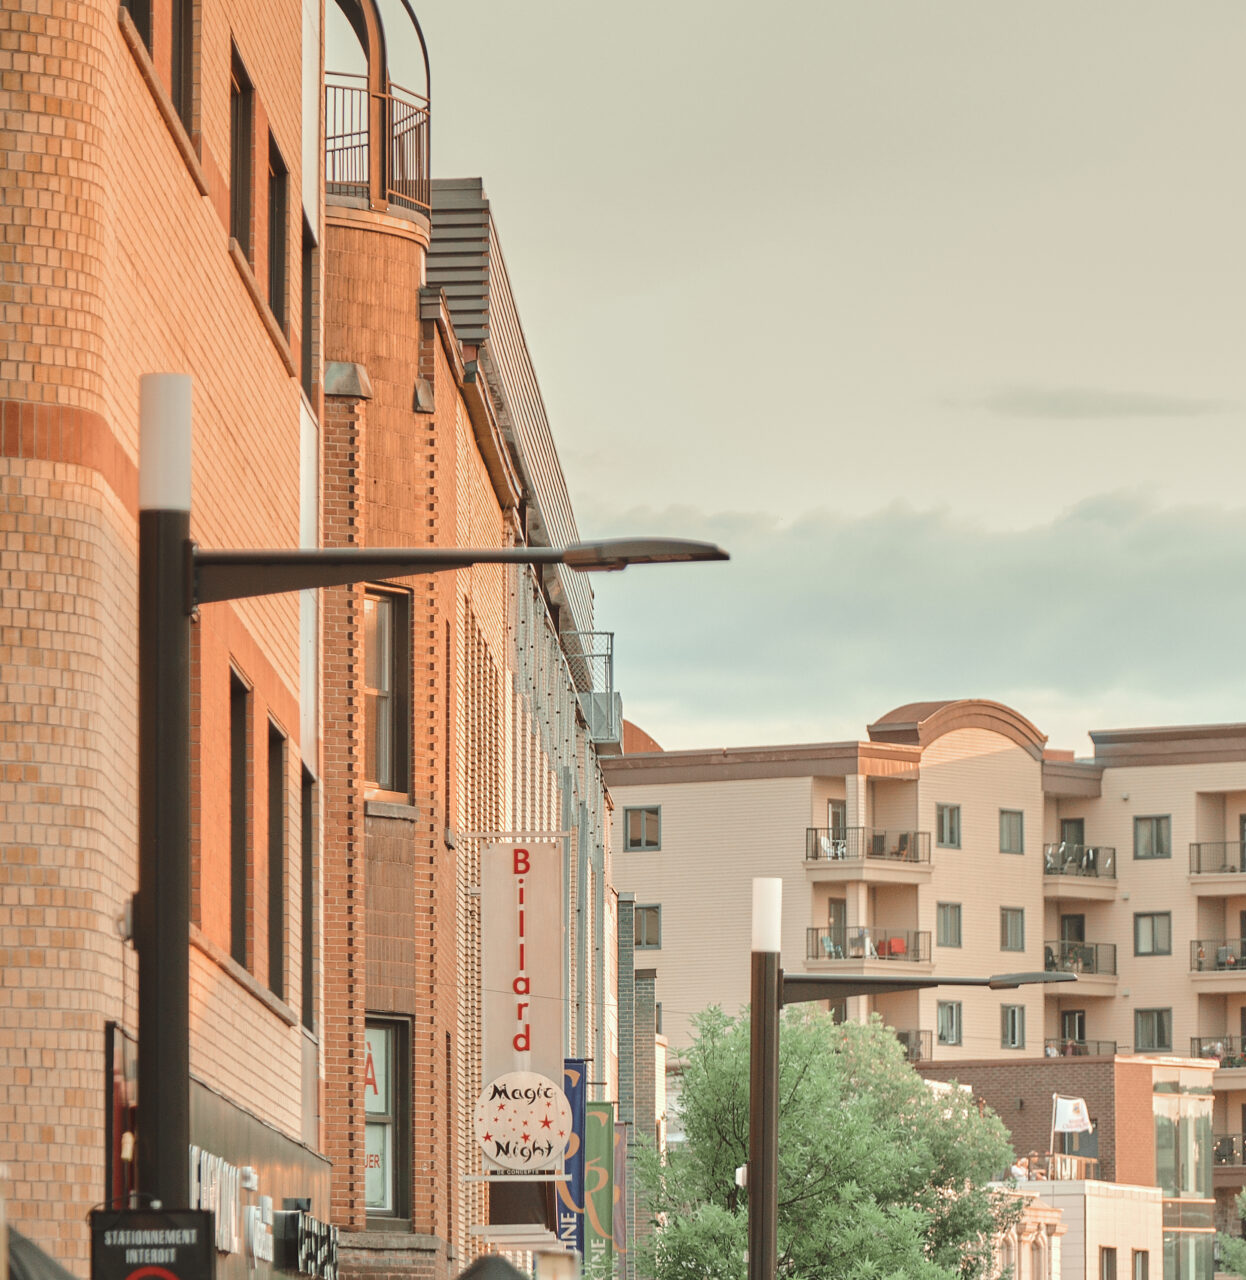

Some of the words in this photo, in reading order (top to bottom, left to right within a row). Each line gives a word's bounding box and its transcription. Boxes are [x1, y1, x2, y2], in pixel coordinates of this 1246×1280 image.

[513, 848, 531, 1052] Billard
[364, 1041, 379, 1096] À
[489, 1083, 554, 1105] Magic
[495, 1140, 554, 1163] Night
[104, 1229, 198, 1246] STATIONNEMENT
[126, 1248, 176, 1264] INTERDIT
